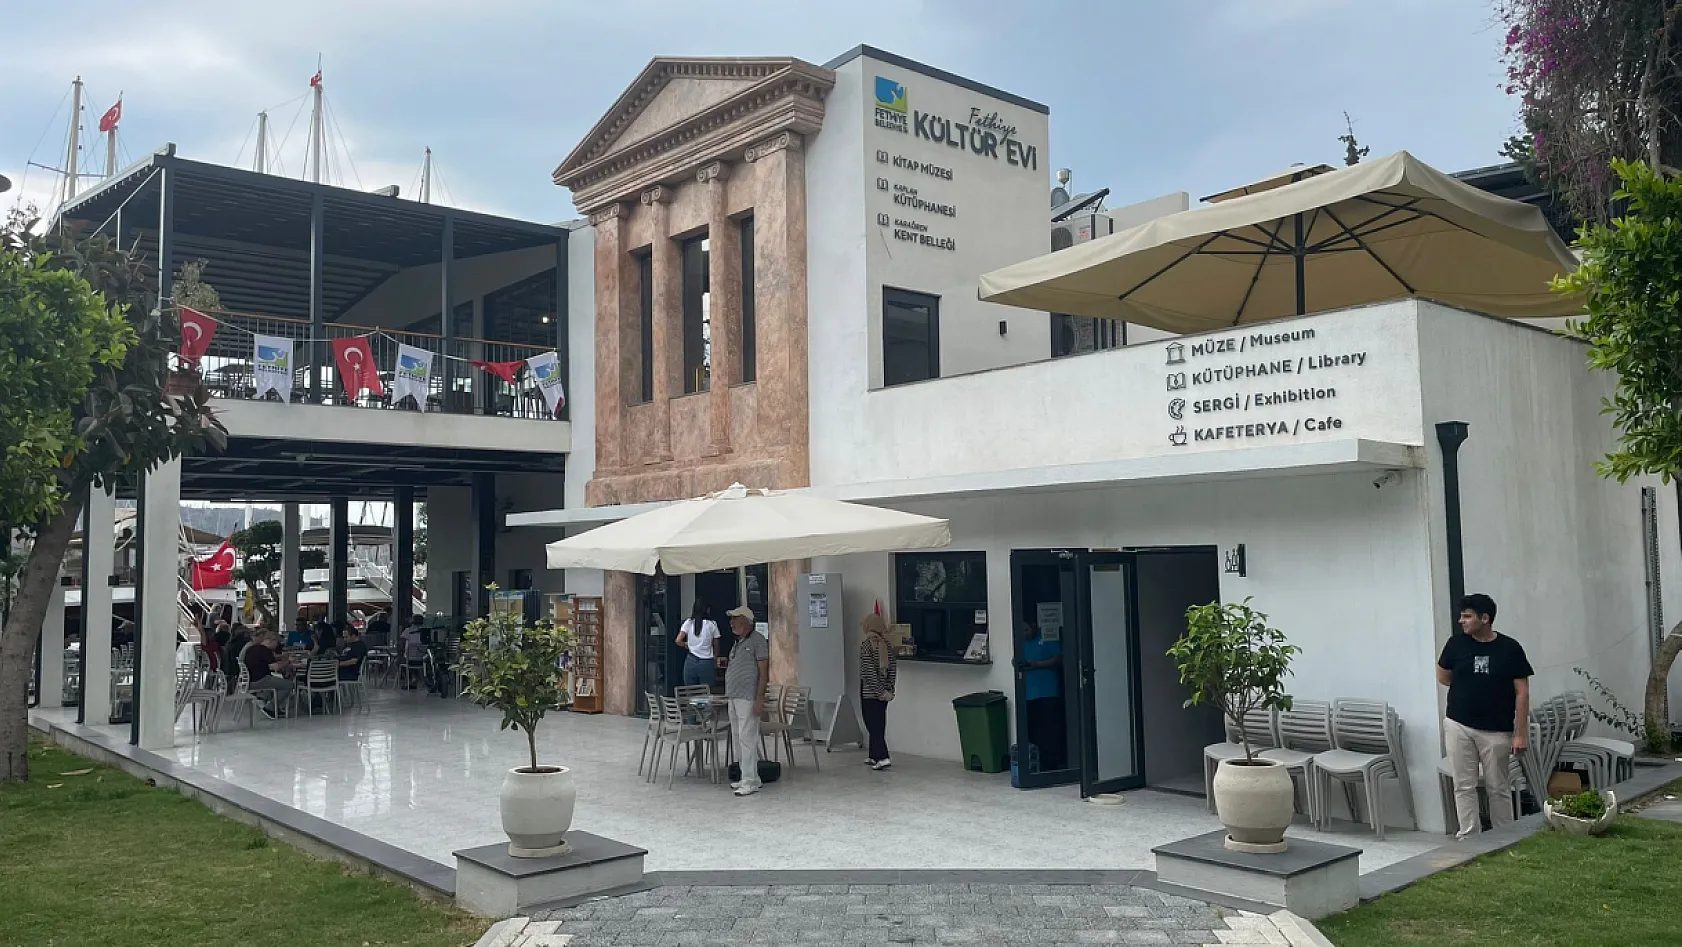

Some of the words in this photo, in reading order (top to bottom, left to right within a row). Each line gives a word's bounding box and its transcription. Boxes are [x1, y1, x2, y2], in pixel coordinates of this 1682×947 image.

[914, 109, 998, 159] KÜLTÜR
[970, 107, 1017, 145] Fethiye
[893, 155, 919, 171] KİTAP
[920, 163, 953, 180] MÜZESİ
[893, 193, 956, 217] KÜTÜPHANESİ
[894, 229, 918, 244] KENT
[919, 234, 955, 251] BELLEĞİ
[1191, 338, 1236, 357] MÜZE
[1250, 328, 1315, 347] Museum
[1192, 359, 1292, 385] KÜTÜPHANE
[1308, 351, 1367, 370] Library
[1193, 393, 1240, 414] SERGİ
[1255, 387, 1337, 407] Exhibition
[1194, 420, 1289, 442] KAFETERYA
[1304, 416, 1343, 432] Cafe
